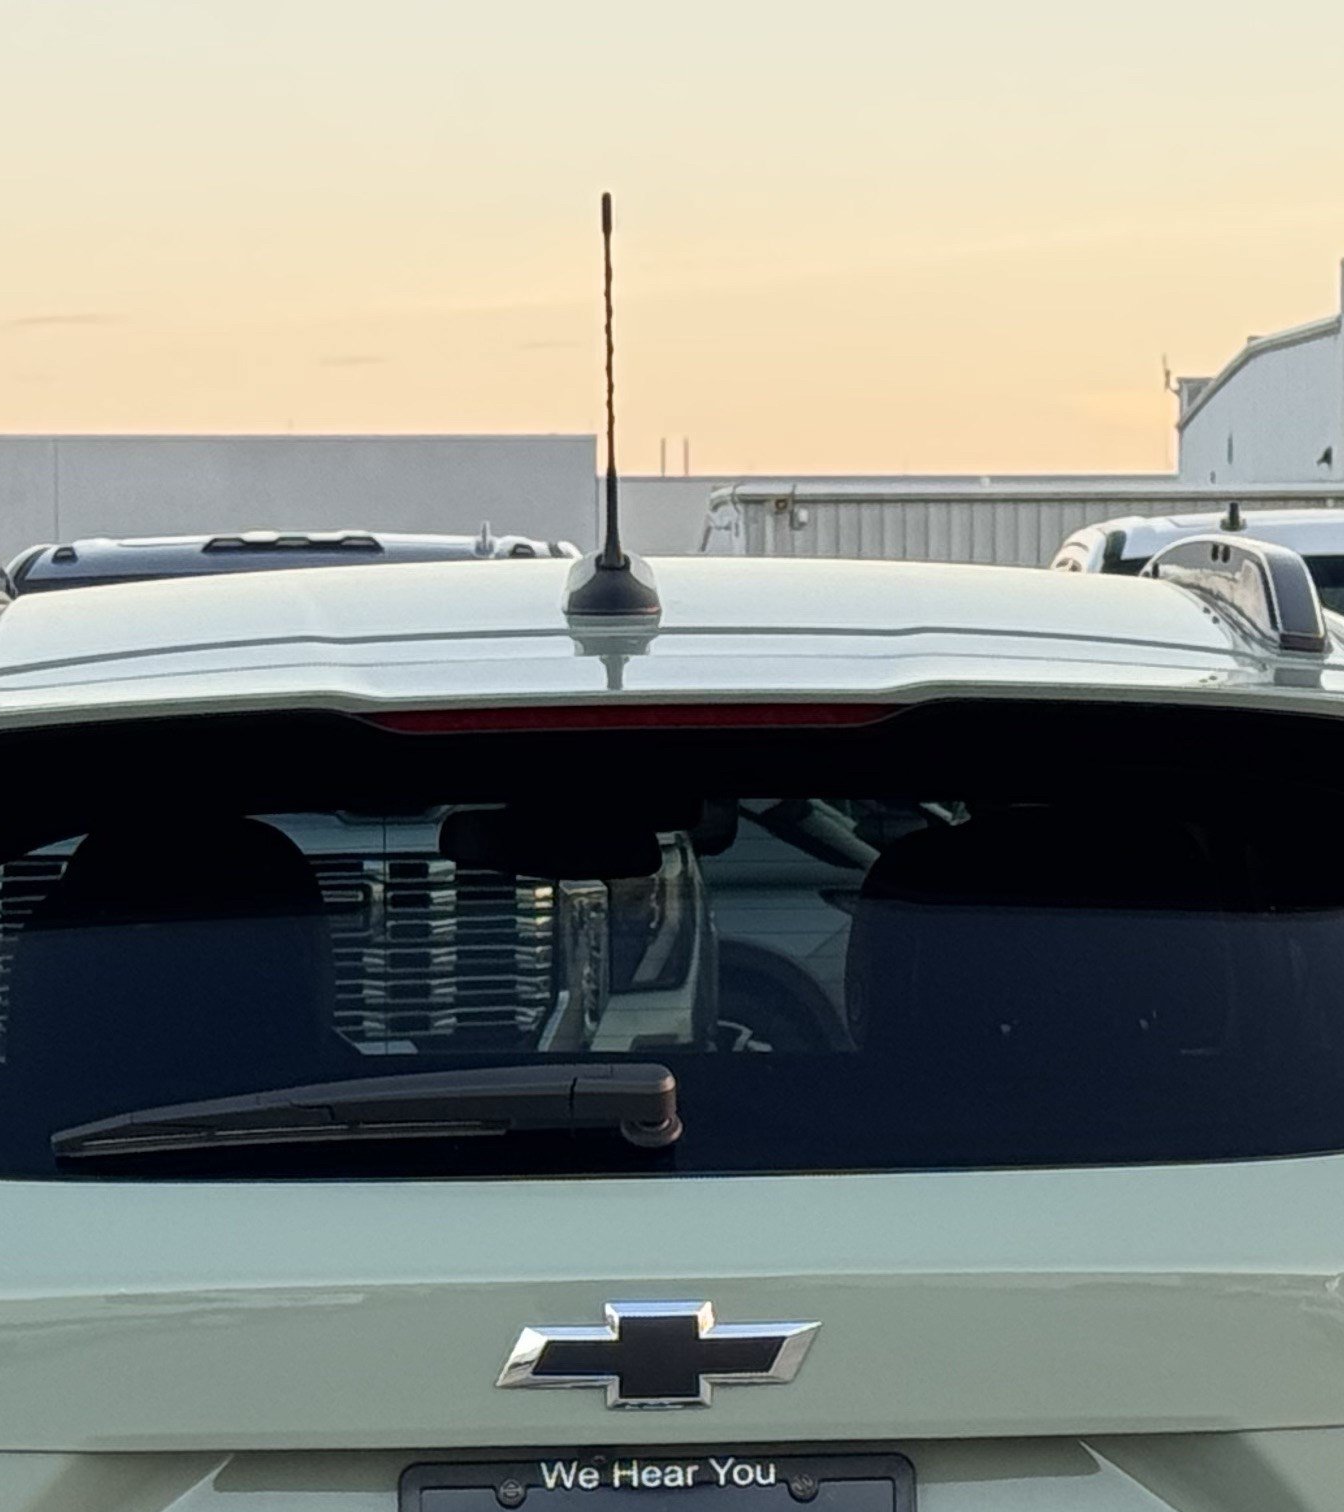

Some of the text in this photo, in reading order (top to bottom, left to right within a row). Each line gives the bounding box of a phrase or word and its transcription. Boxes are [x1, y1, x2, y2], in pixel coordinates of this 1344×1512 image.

[540, 1457, 776, 1490] We Hear You
